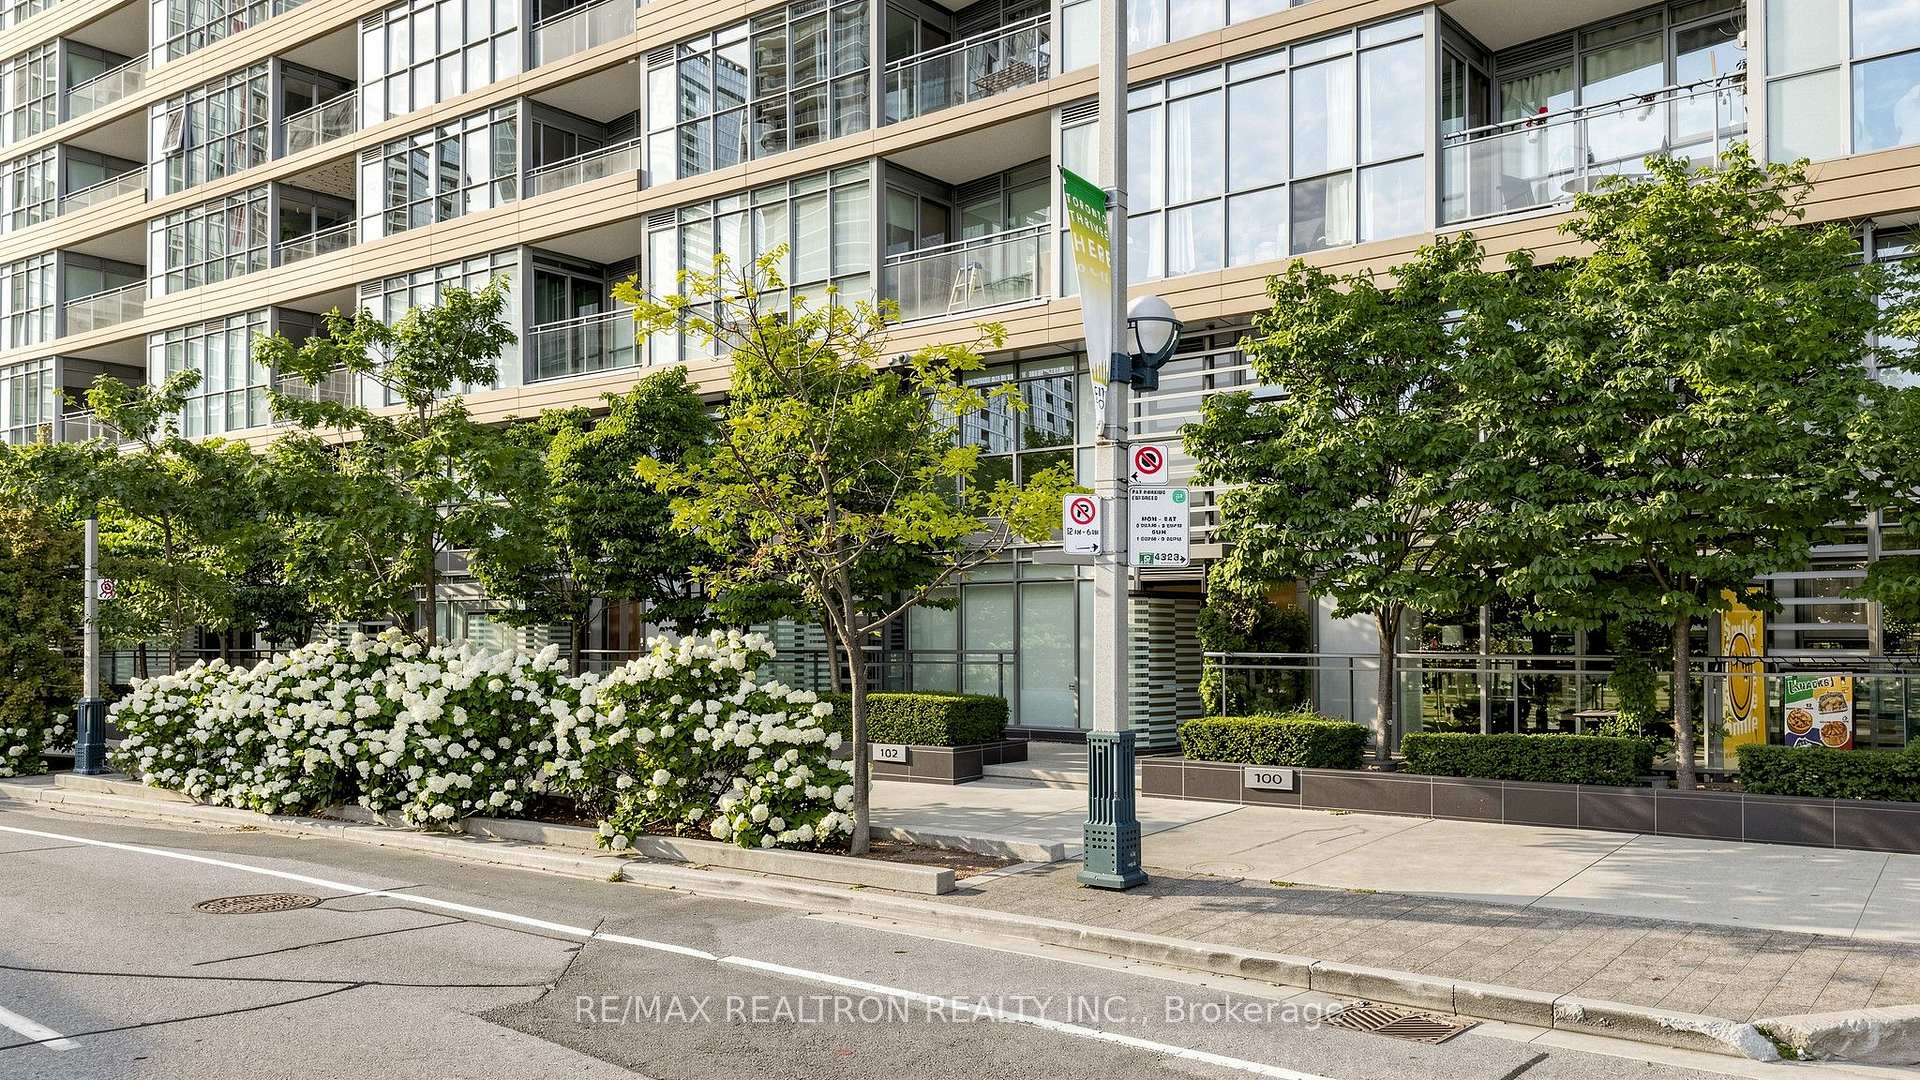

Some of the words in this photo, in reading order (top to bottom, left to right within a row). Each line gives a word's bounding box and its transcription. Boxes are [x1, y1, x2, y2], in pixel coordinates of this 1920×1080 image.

[1073, 233, 1111, 268] HERE
[1154, 553, 1180, 561] 4323
[880, 748, 898, 759] 102
[1254, 773, 1282, 785] 100
